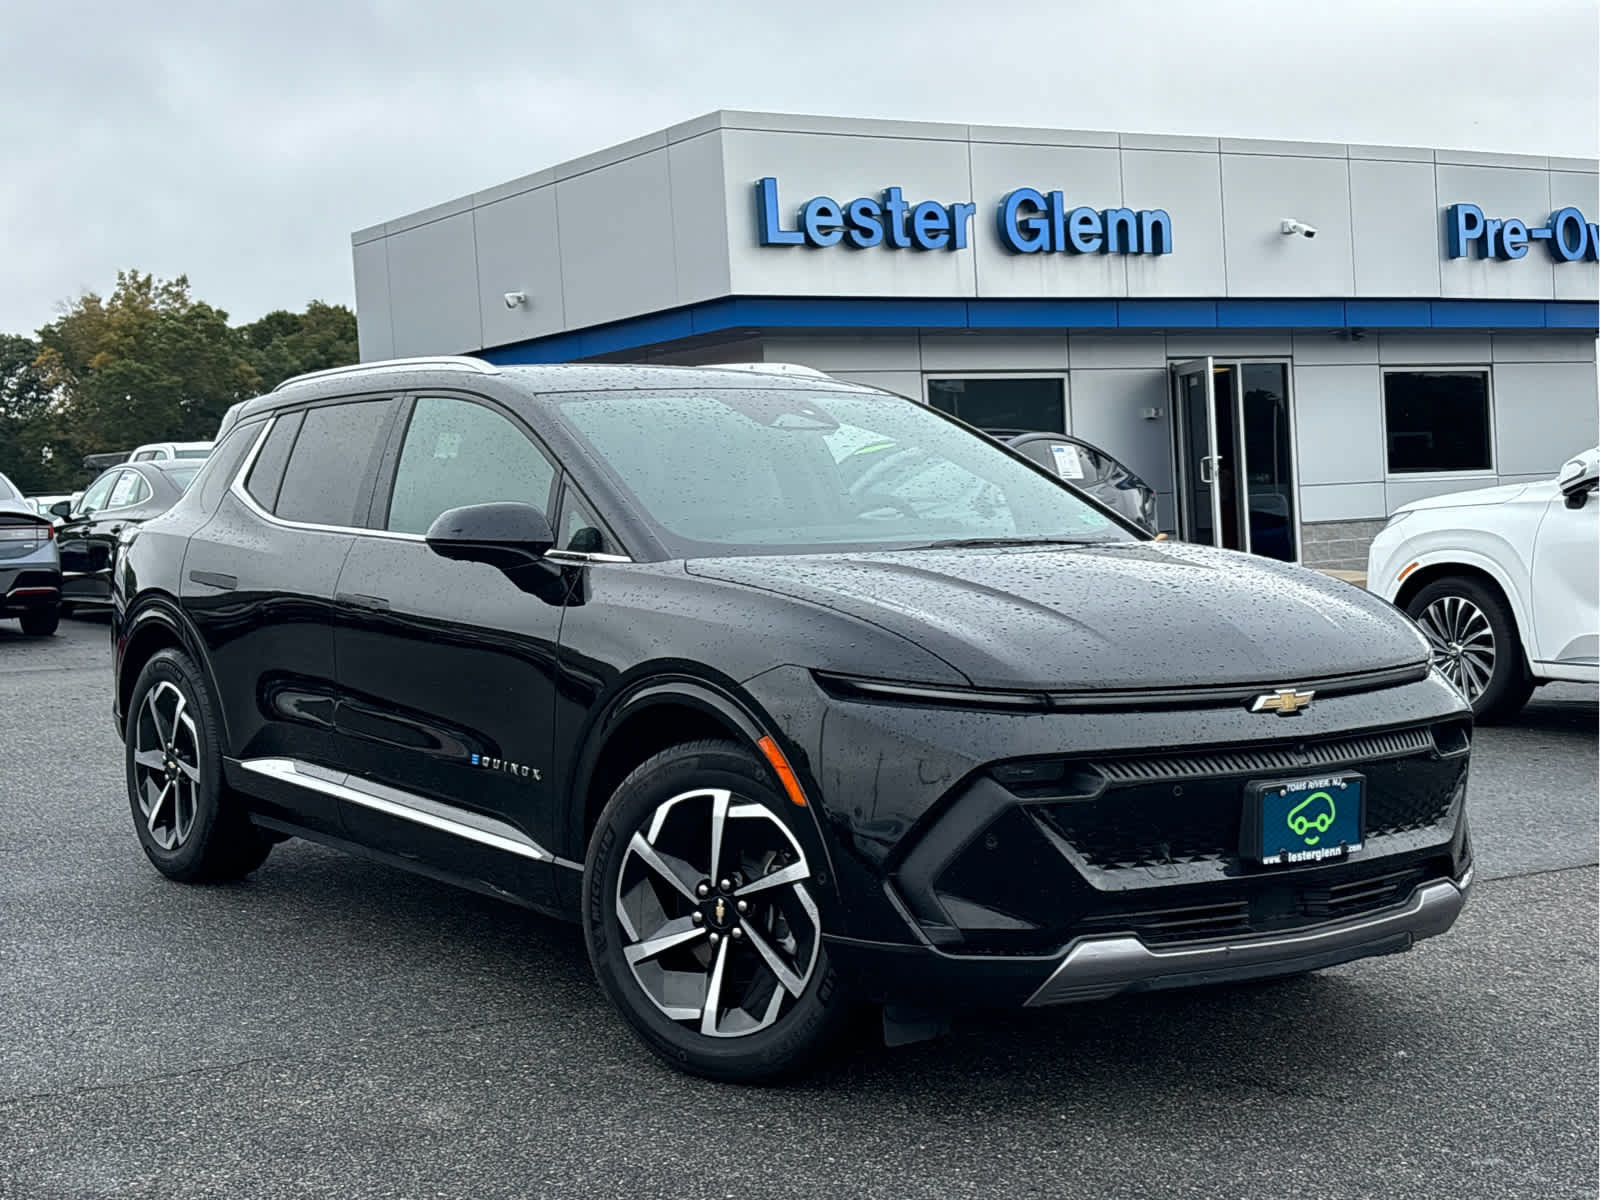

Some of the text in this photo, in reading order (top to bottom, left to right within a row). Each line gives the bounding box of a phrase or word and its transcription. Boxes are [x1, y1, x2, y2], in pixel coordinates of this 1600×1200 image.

[757, 177, 1173, 255] Lester Glenn
[471, 753, 541, 781] EQUINOX
[1287, 781, 1307, 792] TOMS
[1332, 776, 1342, 787] NJ
[1288, 846, 1342, 863] lesterglenn
